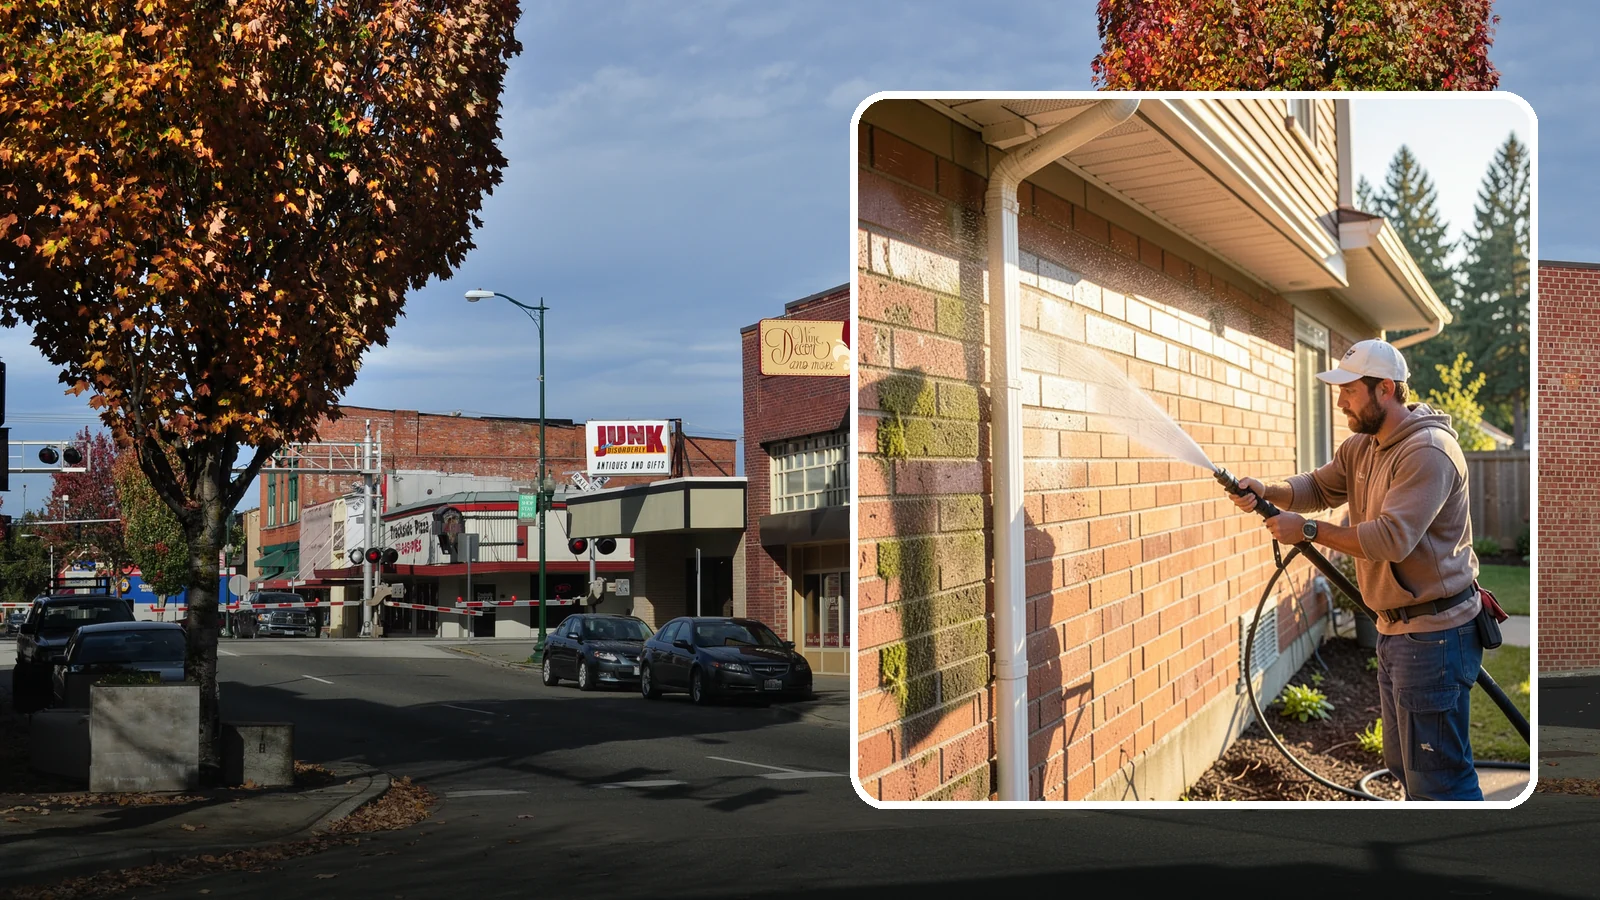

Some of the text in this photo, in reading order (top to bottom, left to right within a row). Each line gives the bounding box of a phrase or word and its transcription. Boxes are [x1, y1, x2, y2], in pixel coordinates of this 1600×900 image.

[595, 425, 665, 457] JUNK
[607, 446, 646, 454] DISORDERLY
[596, 460, 665, 470] ANTIQUES AND GIFTS
[414, 519, 429, 534] Pizza
